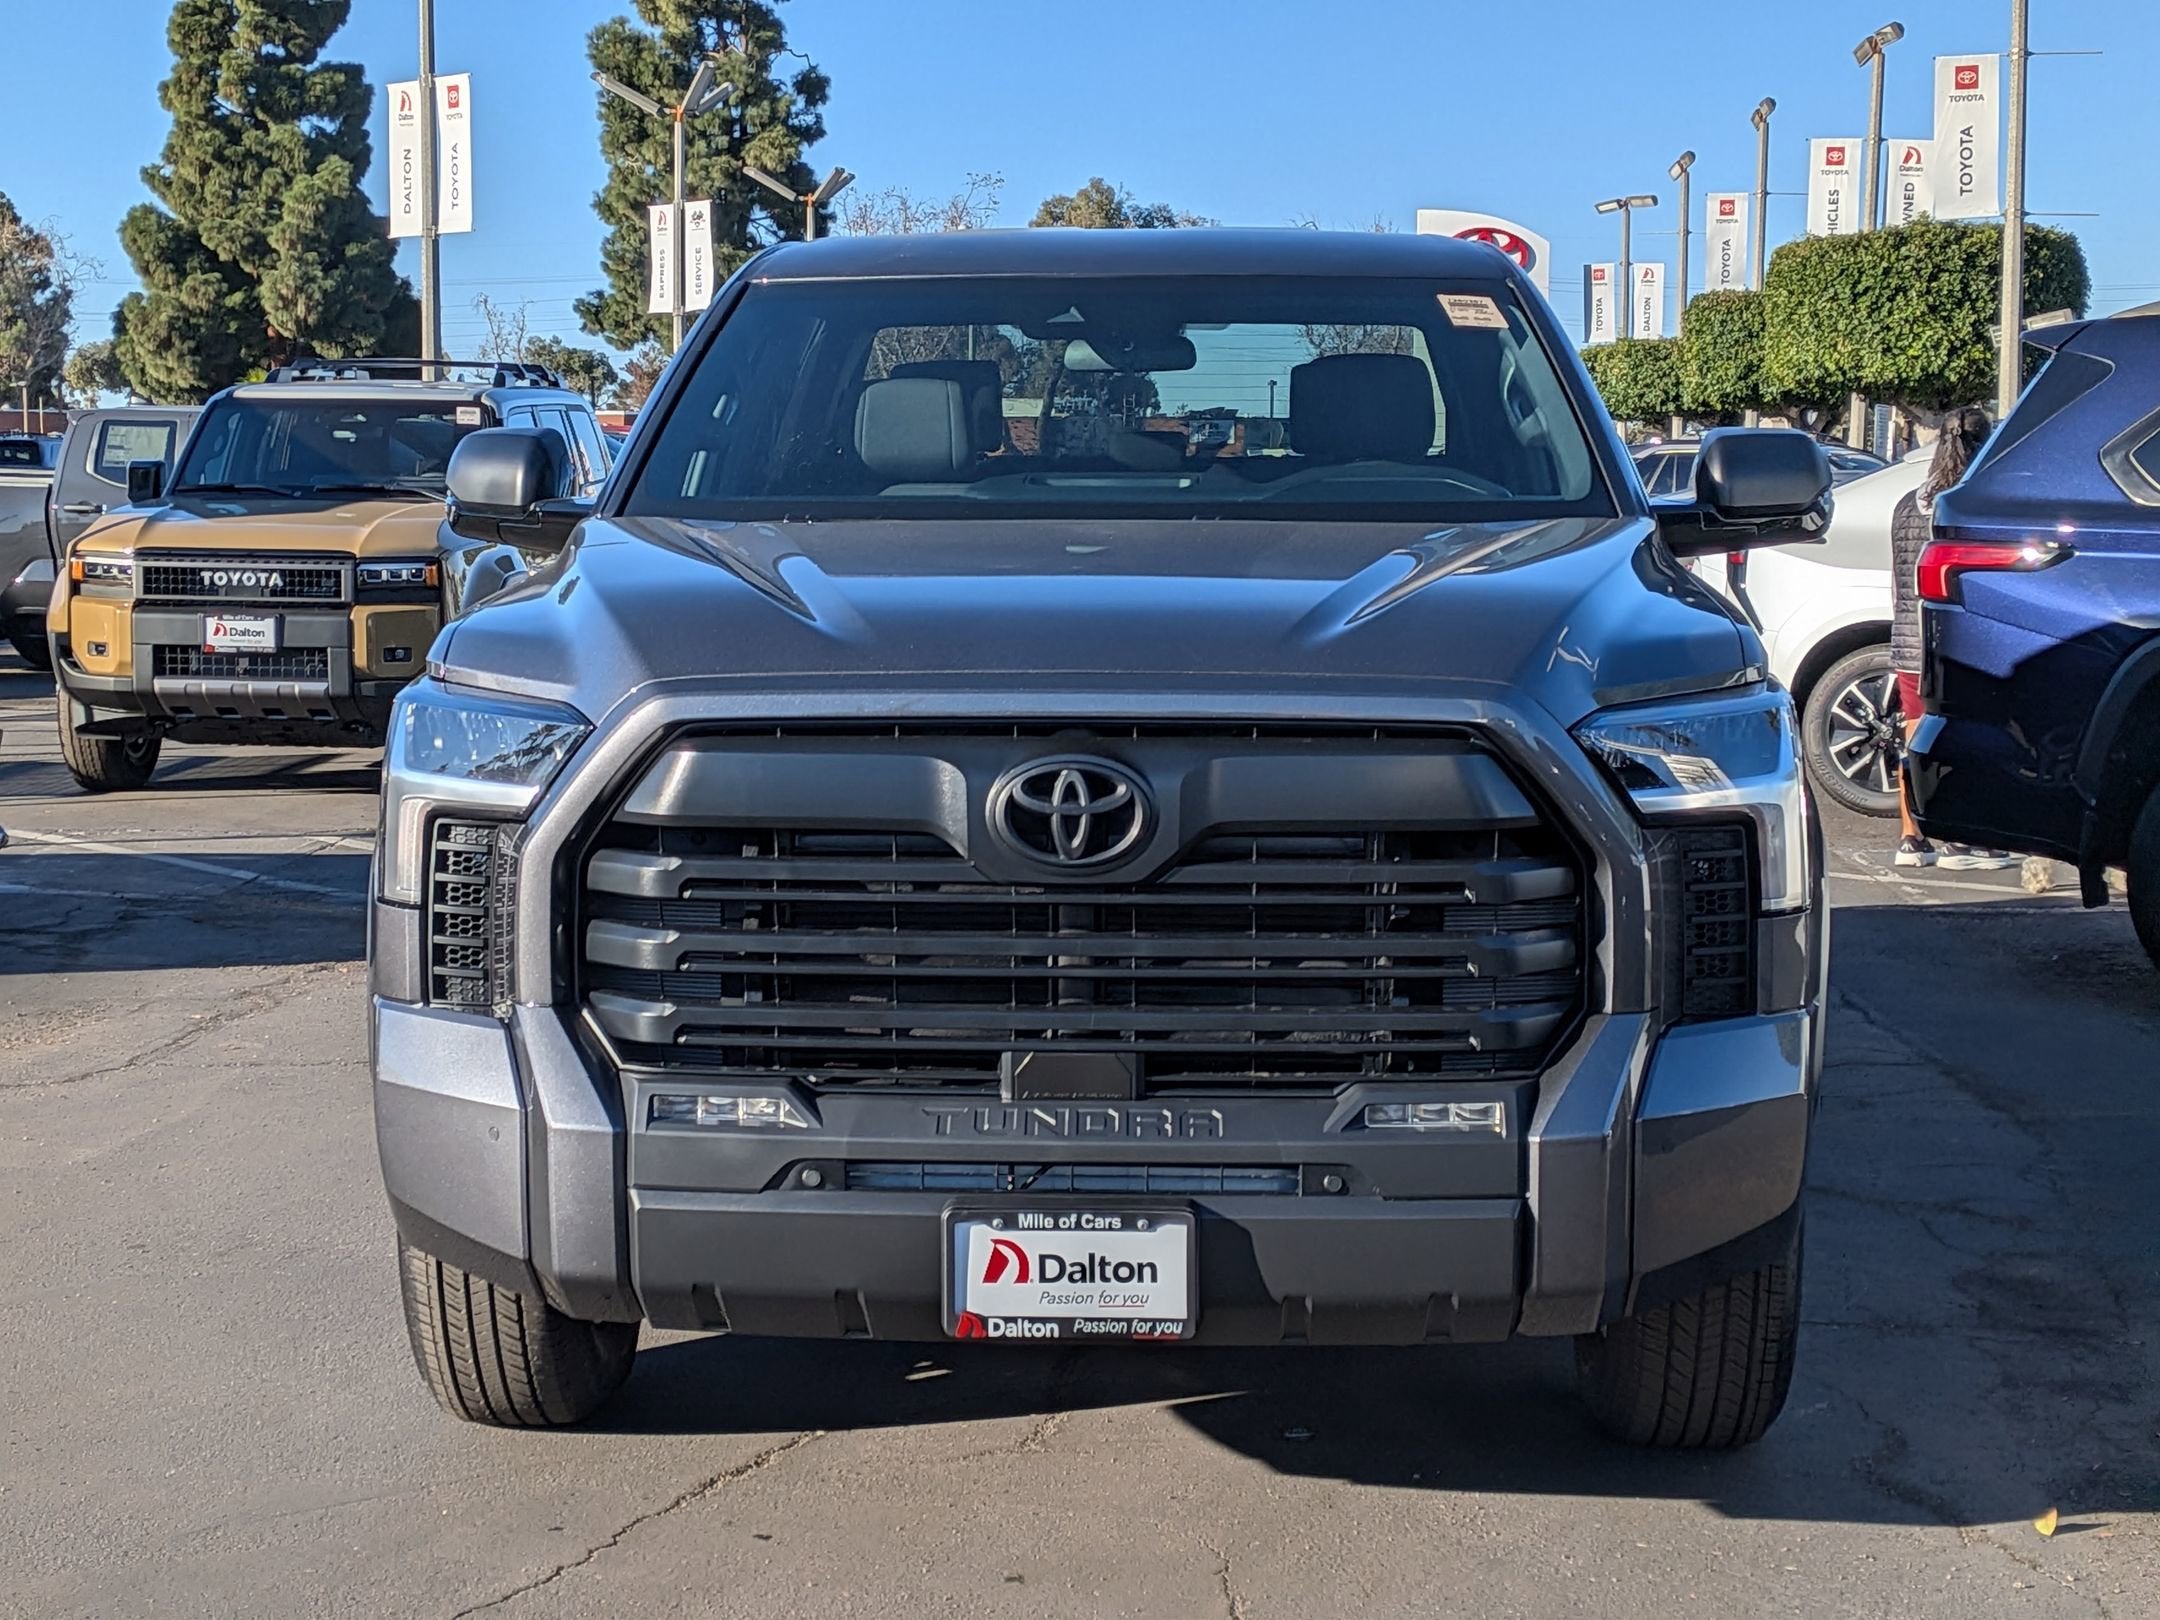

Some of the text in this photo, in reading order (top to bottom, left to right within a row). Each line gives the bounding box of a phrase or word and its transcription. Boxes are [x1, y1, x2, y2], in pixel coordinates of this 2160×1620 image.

[1949, 94, 1985, 103] TOYOTA
[451, 142, 459, 211] TOYOTA
[1899, 165, 1924, 173] Dalton
[1959, 125, 1974, 197] TOYOTA
[403, 148, 412, 214] DALTON
[1827, 189, 1840, 235] HICLES
[1902, 182, 1915, 226] WNED
[1720, 238, 1731, 285] TOYOTA
[1595, 297, 1604, 332] TOYOTA
[1643, 297, 1652, 332] DALTON
[200, 571, 284, 587] TOYOTA
[229, 627, 265, 637] Dalton
[922, 1107, 1224, 1138] TUNDRA
[1018, 1213, 1122, 1230] Mile of Cars
[1038, 1252, 1159, 1285] Dalton
[1039, 1289, 1150, 1309] Passion for you
[987, 1317, 1183, 1338] Dalton Passion for you
